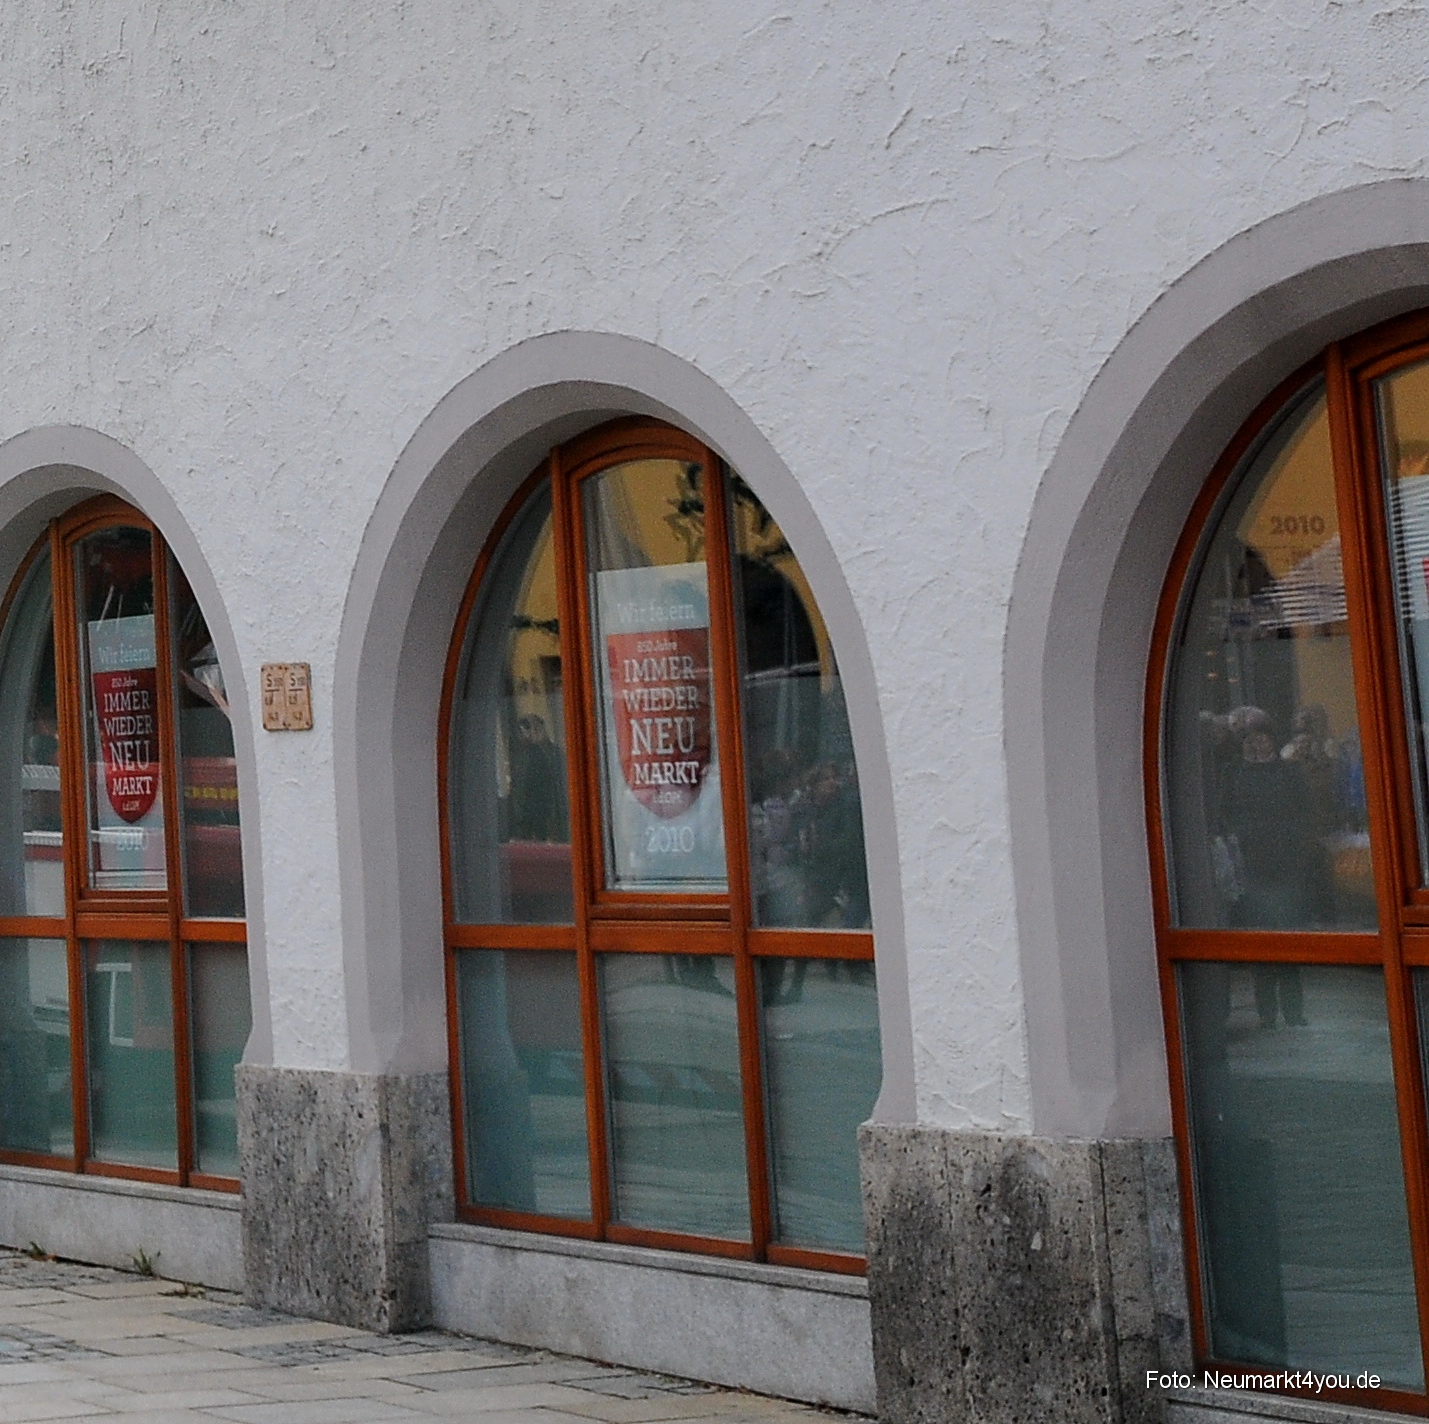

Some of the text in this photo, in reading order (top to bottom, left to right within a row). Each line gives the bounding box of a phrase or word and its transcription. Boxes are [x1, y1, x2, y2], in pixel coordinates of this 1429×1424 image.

[624, 656, 695, 683] IMMER
[104, 690, 150, 713] IMMER
[622, 686, 698, 712] WIEDER
[104, 715, 153, 736] WIEDER
[630, 716, 695, 755] NEU
[109, 740, 150, 771] NEU
[112, 776, 153, 796] MARKT
[634, 761, 699, 785] MARKT
[645, 826, 695, 852] 2010
